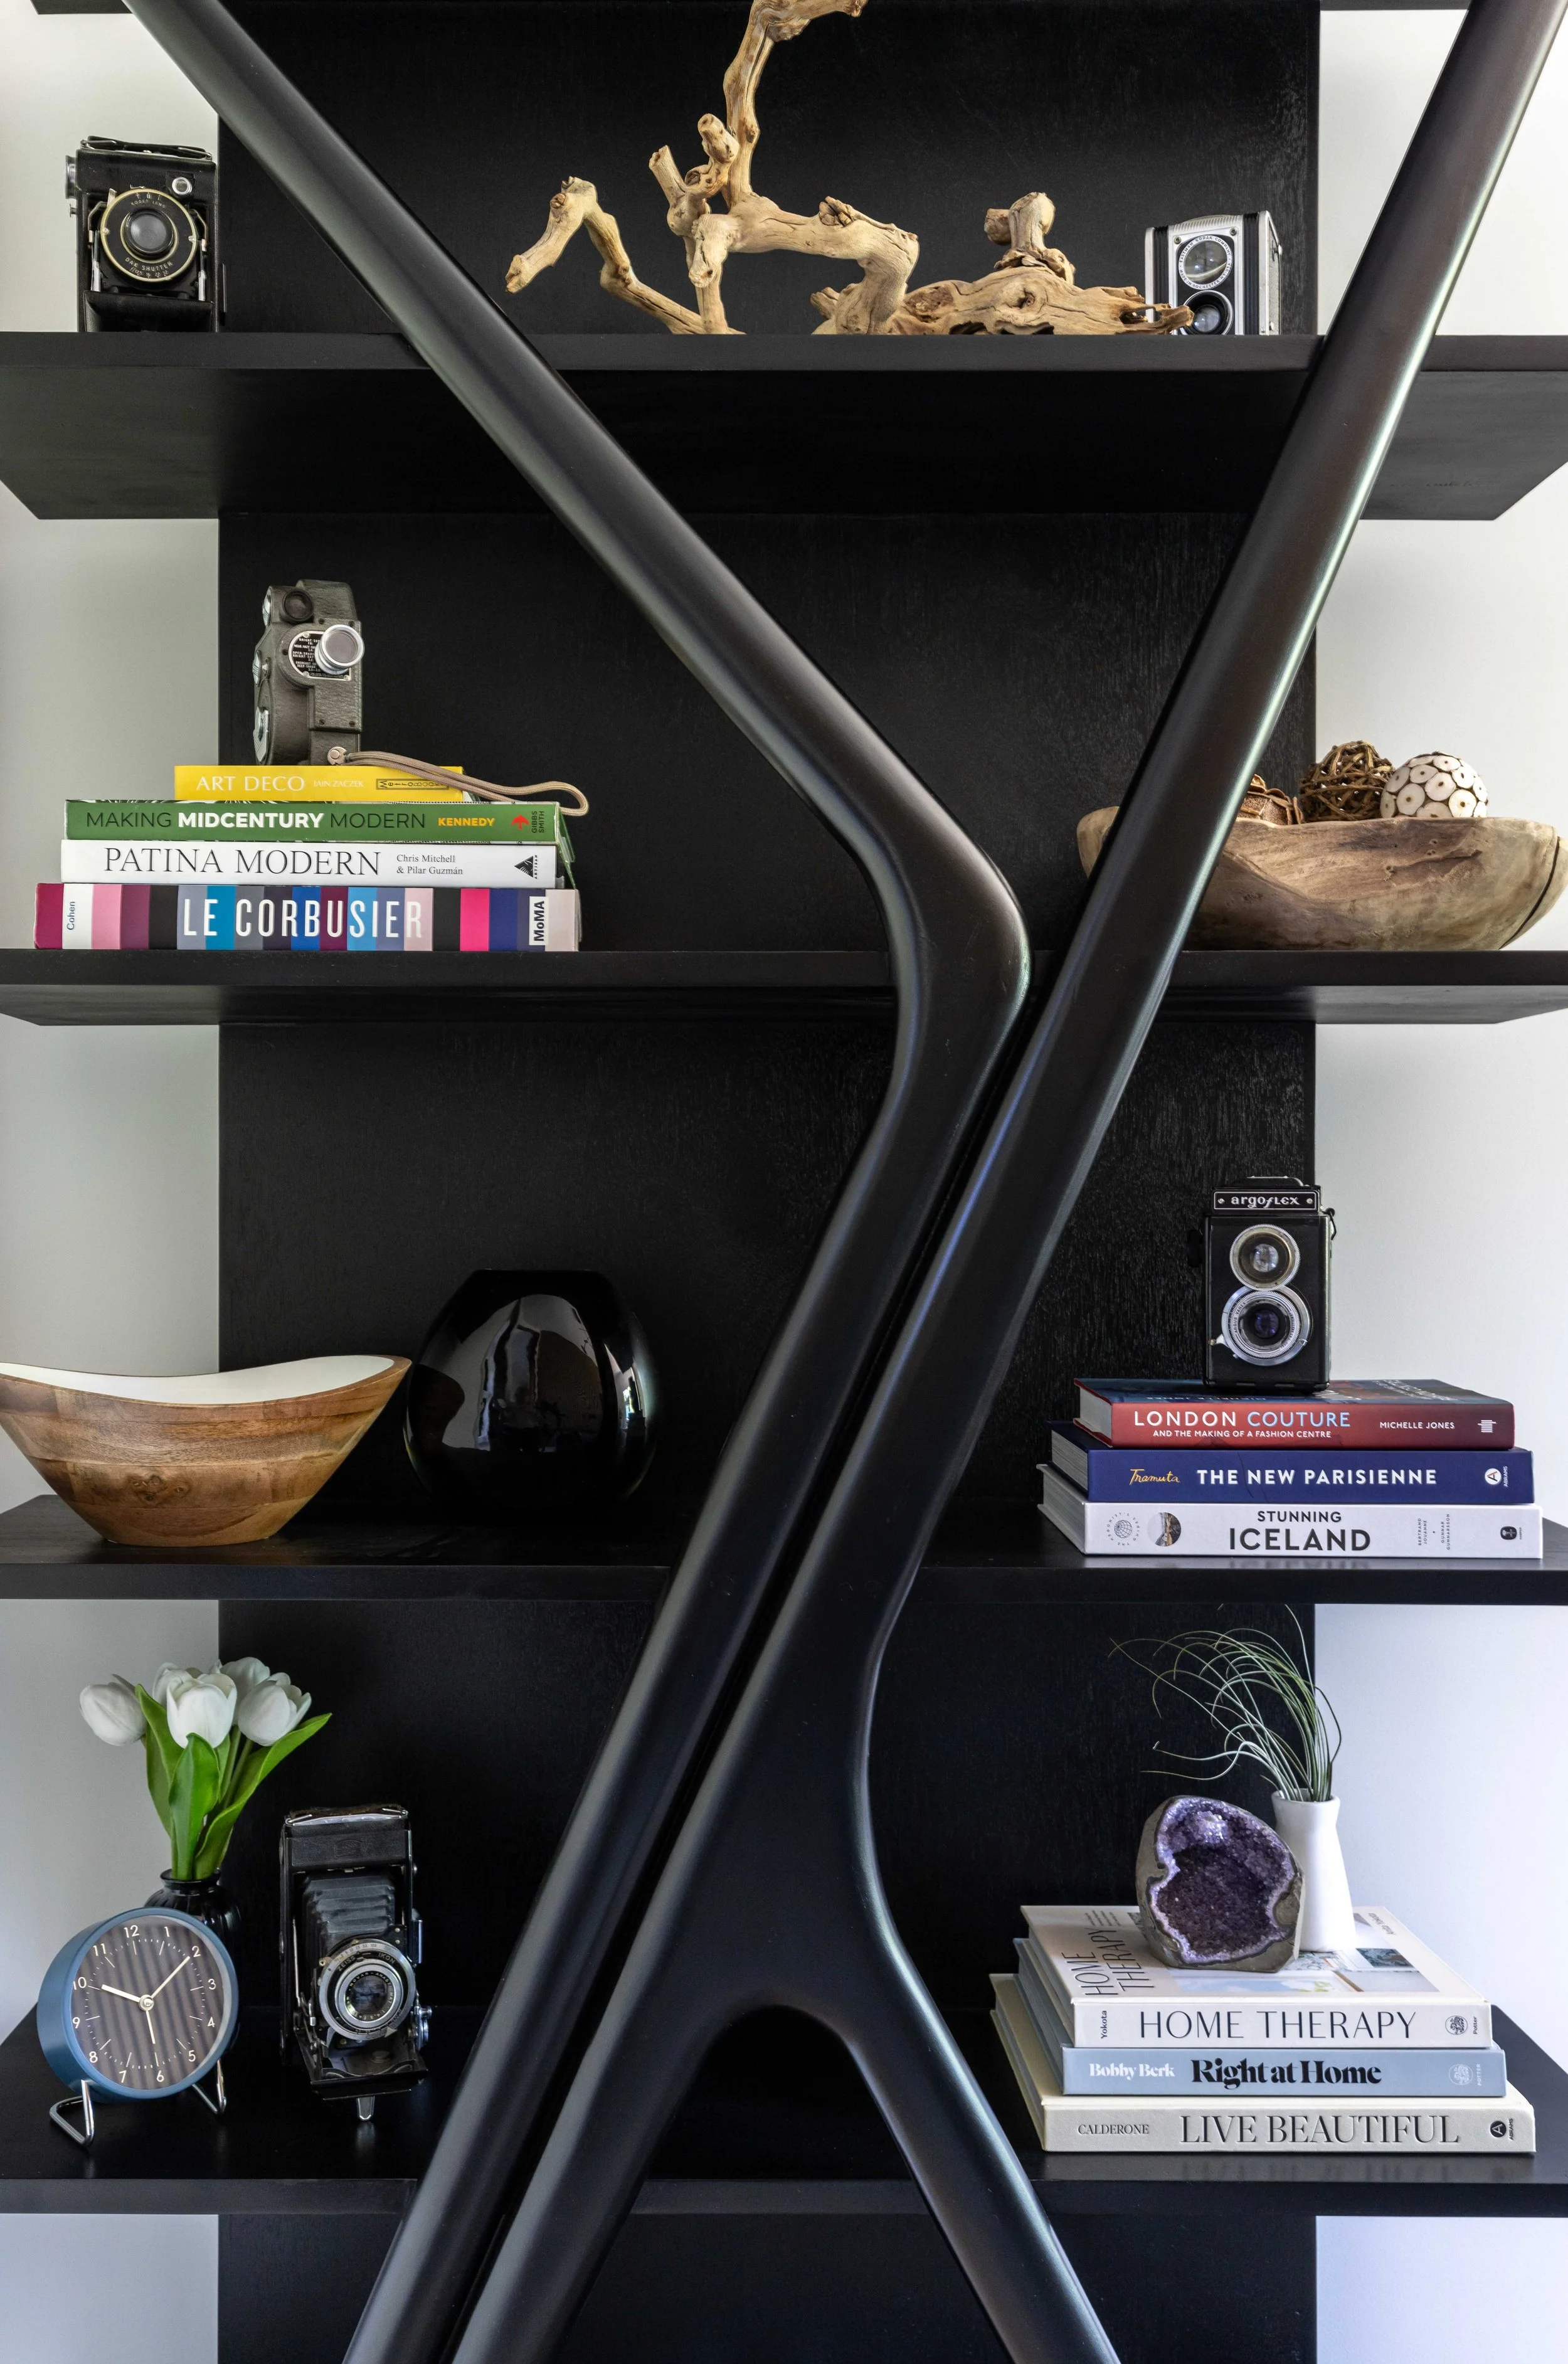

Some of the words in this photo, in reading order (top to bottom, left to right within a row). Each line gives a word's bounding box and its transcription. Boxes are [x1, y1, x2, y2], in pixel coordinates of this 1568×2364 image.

[1179, 241, 1194, 263] EASTMAN
[1215, 237, 1231, 255] COMPANY
[125, 257, 138, 268] DAK
[142, 261, 173, 272] SHUTTER
[196, 776, 236, 791] ART
[244, 776, 305, 792] DECO
[87, 812, 171, 827] MAKING
[178, 812, 324, 828] MIDCENTURY
[331, 813, 425, 829] MODERN
[438, 817, 495, 827] KENNEDY
[103, 848, 223, 873] PATINA
[235, 850, 381, 875] MODERN
[396, 854, 418, 863] Chris
[421, 855, 456, 863] Mitchell
[407, 866, 426, 874] Pilar
[429, 866, 463, 874] Guzmán
[66, 901, 75, 931] Cohen
[184, 899, 218, 936] LE
[235, 899, 422, 938] CORBUSIER
[534, 901, 544, 941] MoMA
[1135, 1411, 1236, 1427] LONDON
[1247, 1411, 1350, 1428] COUTURE
[1130, 1468, 1180, 1486] Tramuta
[1197, 1470, 1238, 1484] THE
[1248, 1470, 1295, 1484] NEW
[1305, 1469, 1437, 1485] PARISIENNE
[1257, 1511, 1342, 1522] STUNNING
[1230, 1528, 1370, 1551] ICELAND
[124, 1924, 139, 1938] 12
[164, 1926, 170, 1937] 1
[93, 1943, 107, 1956] 11
[191, 1946, 201, 1958] 2
[338, 1956, 356, 1971] ZEISS
[378, 1952, 396, 1964] IKON
[1084, 1927, 1155, 1991] THERAPY
[1061, 1951, 1119, 1995] HOME
[73, 1977, 87, 1990] 10
[208, 1978, 216, 1990] 3
[72, 2017, 80, 2028] 9
[208, 2017, 215, 2028] 4
[1140, 2010, 1244, 2038] HOME
[1256, 2011, 1416, 2038] THERAPY
[89, 2051, 98, 2063] 8
[188, 2050, 196, 2062] 5
[119, 2070, 127, 2083] 7
[156, 2070, 165, 2082] 6
[1089, 2063, 1137, 2080] Bobby
[1138, 2062, 1175, 2077] Berk
[1191, 2058, 1268, 2090] Right
[1270, 2062, 1296, 2083] at
[1300, 2060, 1382, 2084] Home
[1078, 2124, 1149, 2134] CALDERONE
[1180, 2115, 1258, 2143] LIVE
[1266, 2115, 1459, 2143] BEAUTIFUL
